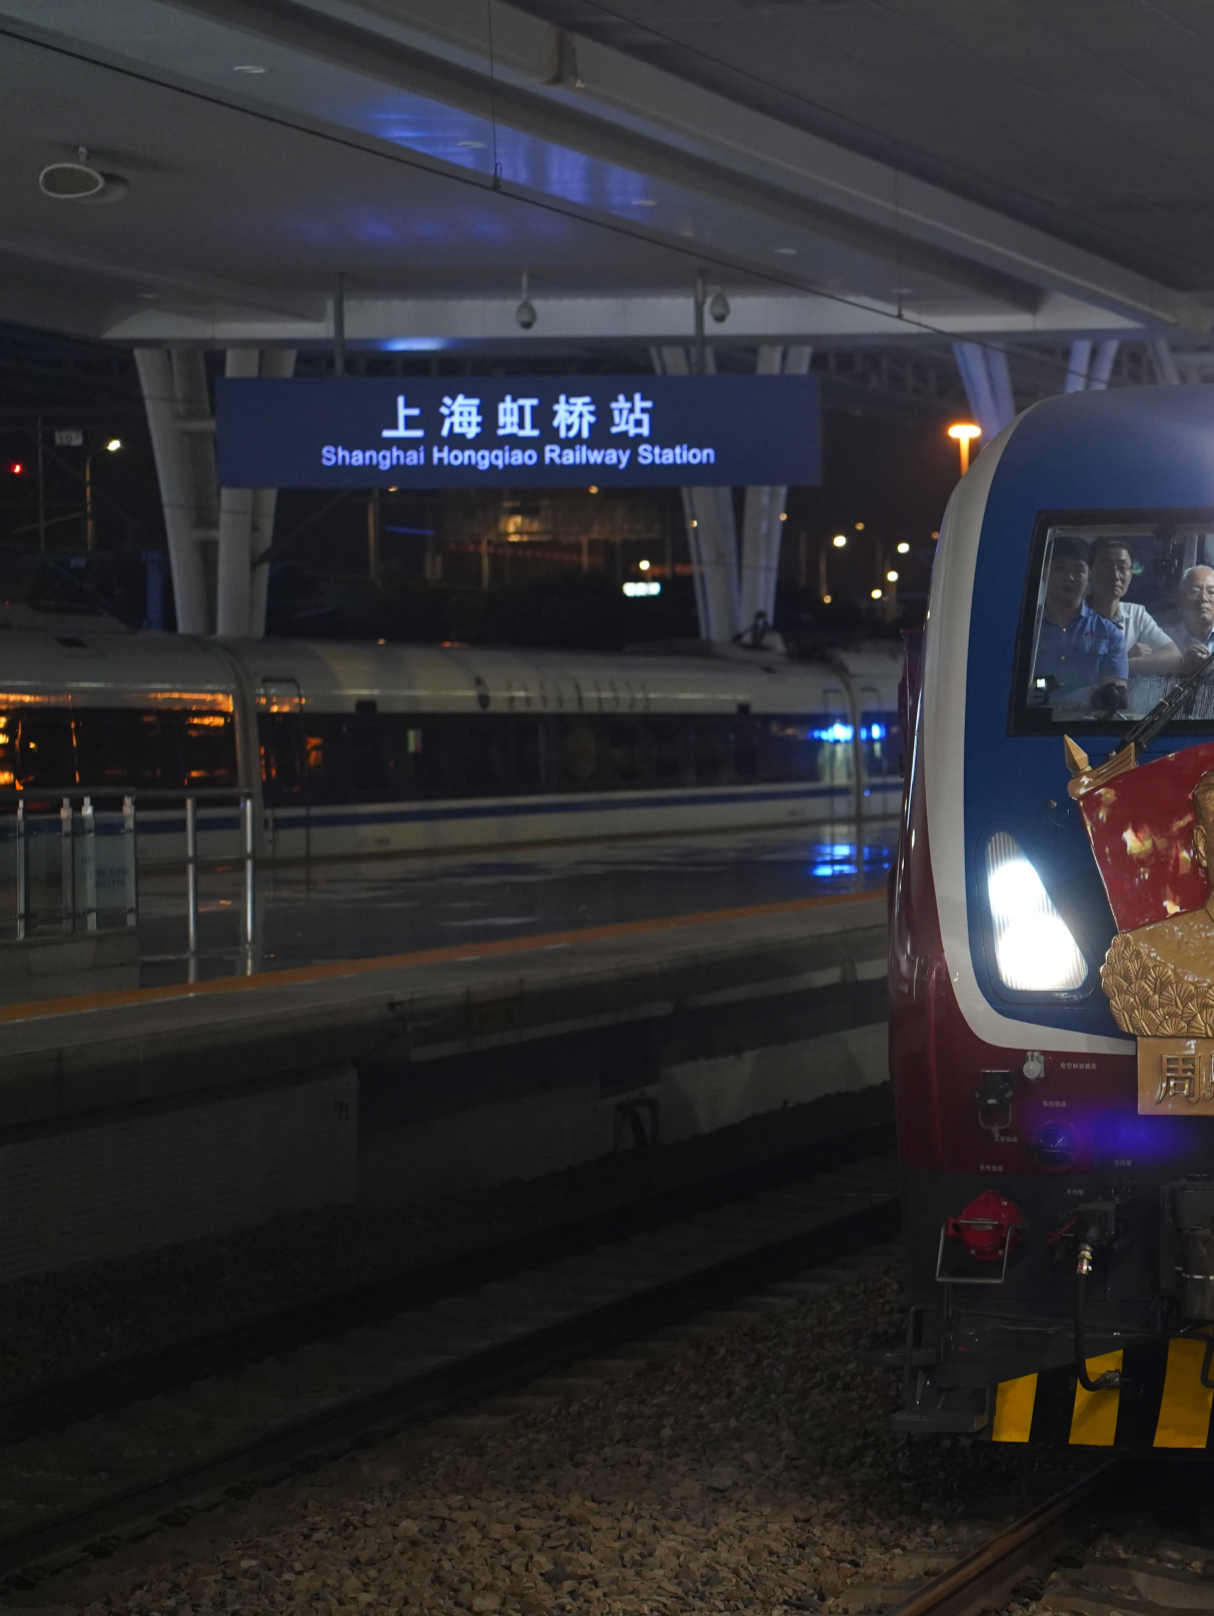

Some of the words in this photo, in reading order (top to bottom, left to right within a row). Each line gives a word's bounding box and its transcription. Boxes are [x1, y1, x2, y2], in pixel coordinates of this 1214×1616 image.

[381, 393, 653, 439] 上海虹桥站
[321, 445, 424, 469] Shanghai
[432, 445, 538, 469] Hongqiao
[545, 444, 631, 469] Railway
[637, 444, 715, 465] Station
[1060, 1062, 1097, 1070] 电空制动插座
